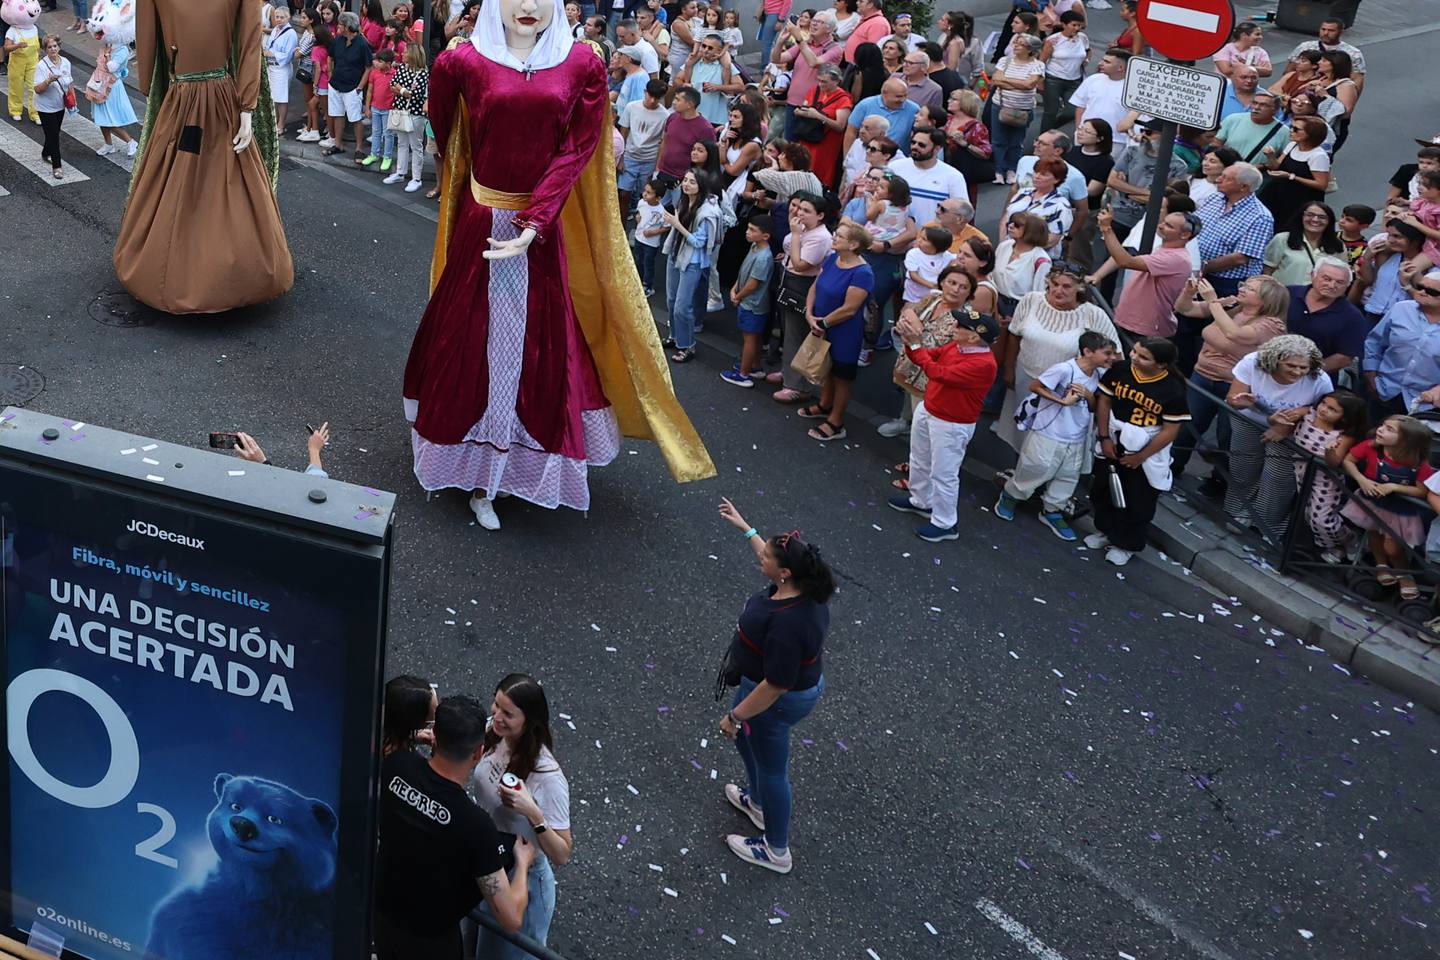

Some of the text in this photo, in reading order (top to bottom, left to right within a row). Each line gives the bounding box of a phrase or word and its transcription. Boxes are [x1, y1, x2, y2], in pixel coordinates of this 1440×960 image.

[1136, 69, 1160, 79] CARGA
[1149, 63, 1200, 81] EXCEPTO
[1157, 81, 1206, 98] LABORABLES
[1135, 96, 1161, 108] ACCESO
[1171, 106, 1204, 119] HOTELES
[1155, 109, 1207, 126] AUTORIZADOS
[126, 519, 205, 550] JCDecaux
[72, 546, 270, 613] Fibra, móvil y sencillez
[50, 578, 295, 669] UNA DECISIÓN
[49, 612, 295, 712] ACERTADA
[36, 906, 132, 952] o2online.es
